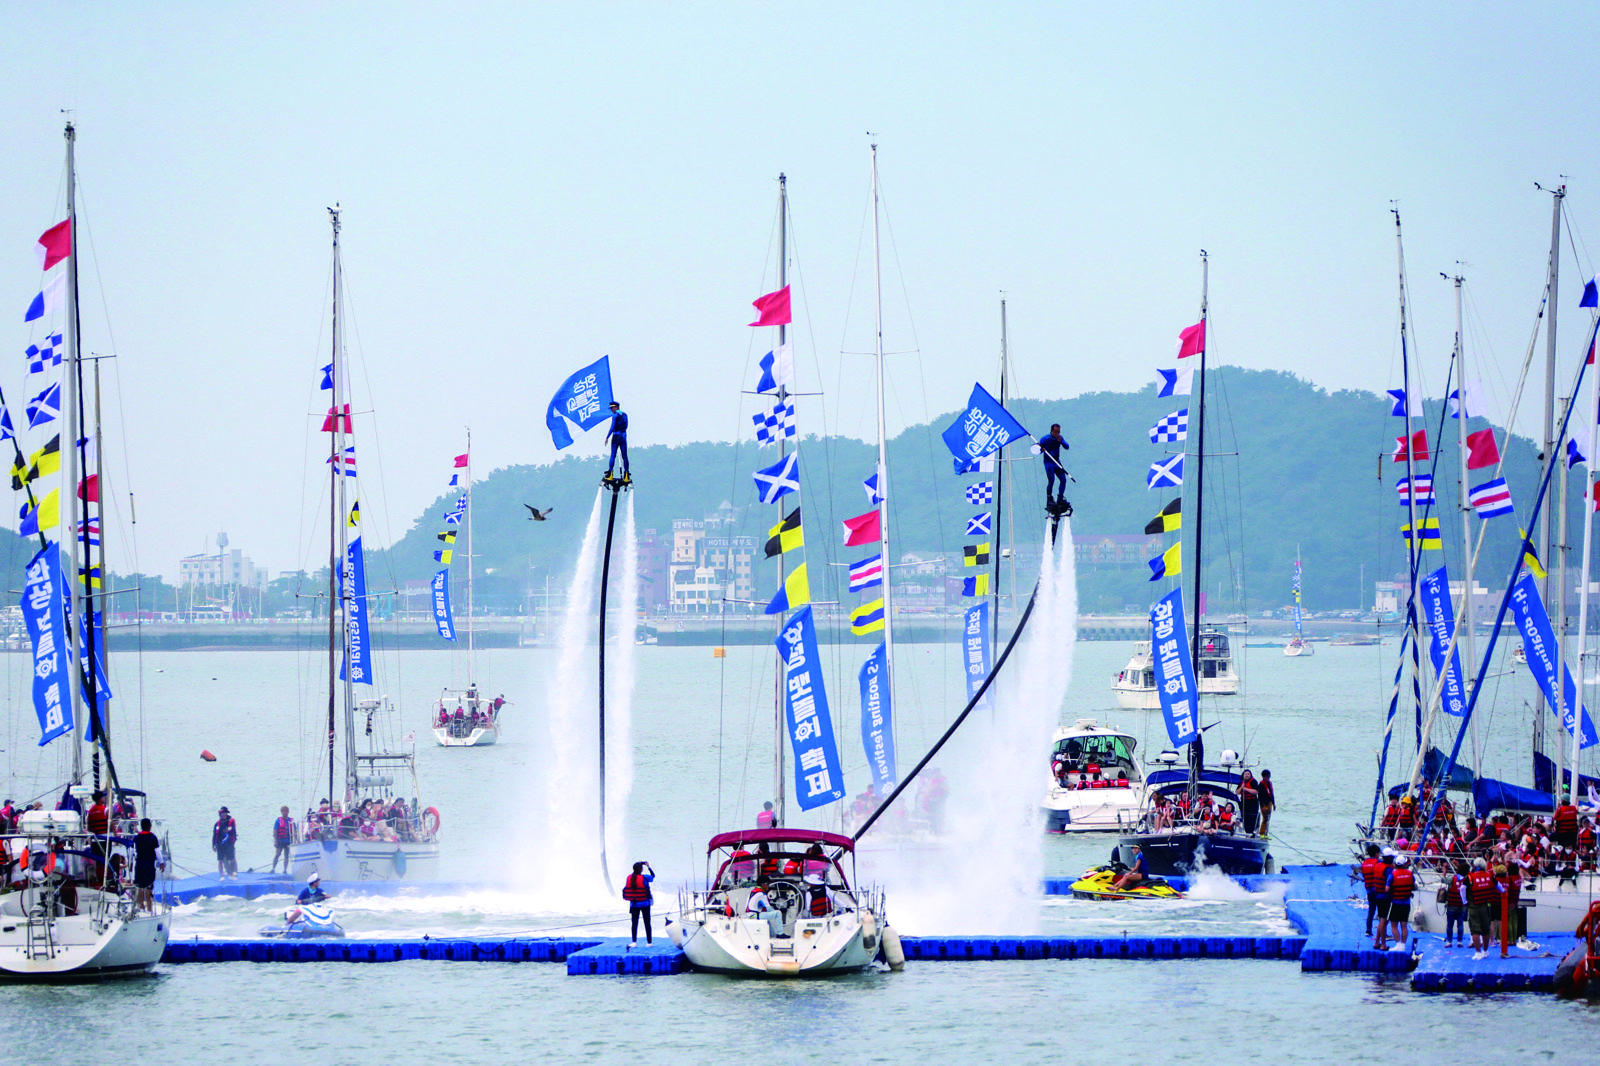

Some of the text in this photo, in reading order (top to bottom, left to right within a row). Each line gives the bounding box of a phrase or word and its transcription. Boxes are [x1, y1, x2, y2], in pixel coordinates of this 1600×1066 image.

[1153, 599, 1174, 639] 화성
[1159, 639, 1188, 696] 뱃놀이
[788, 671, 822, 743] 뱃놀이
[799, 746, 833, 798] 축제
